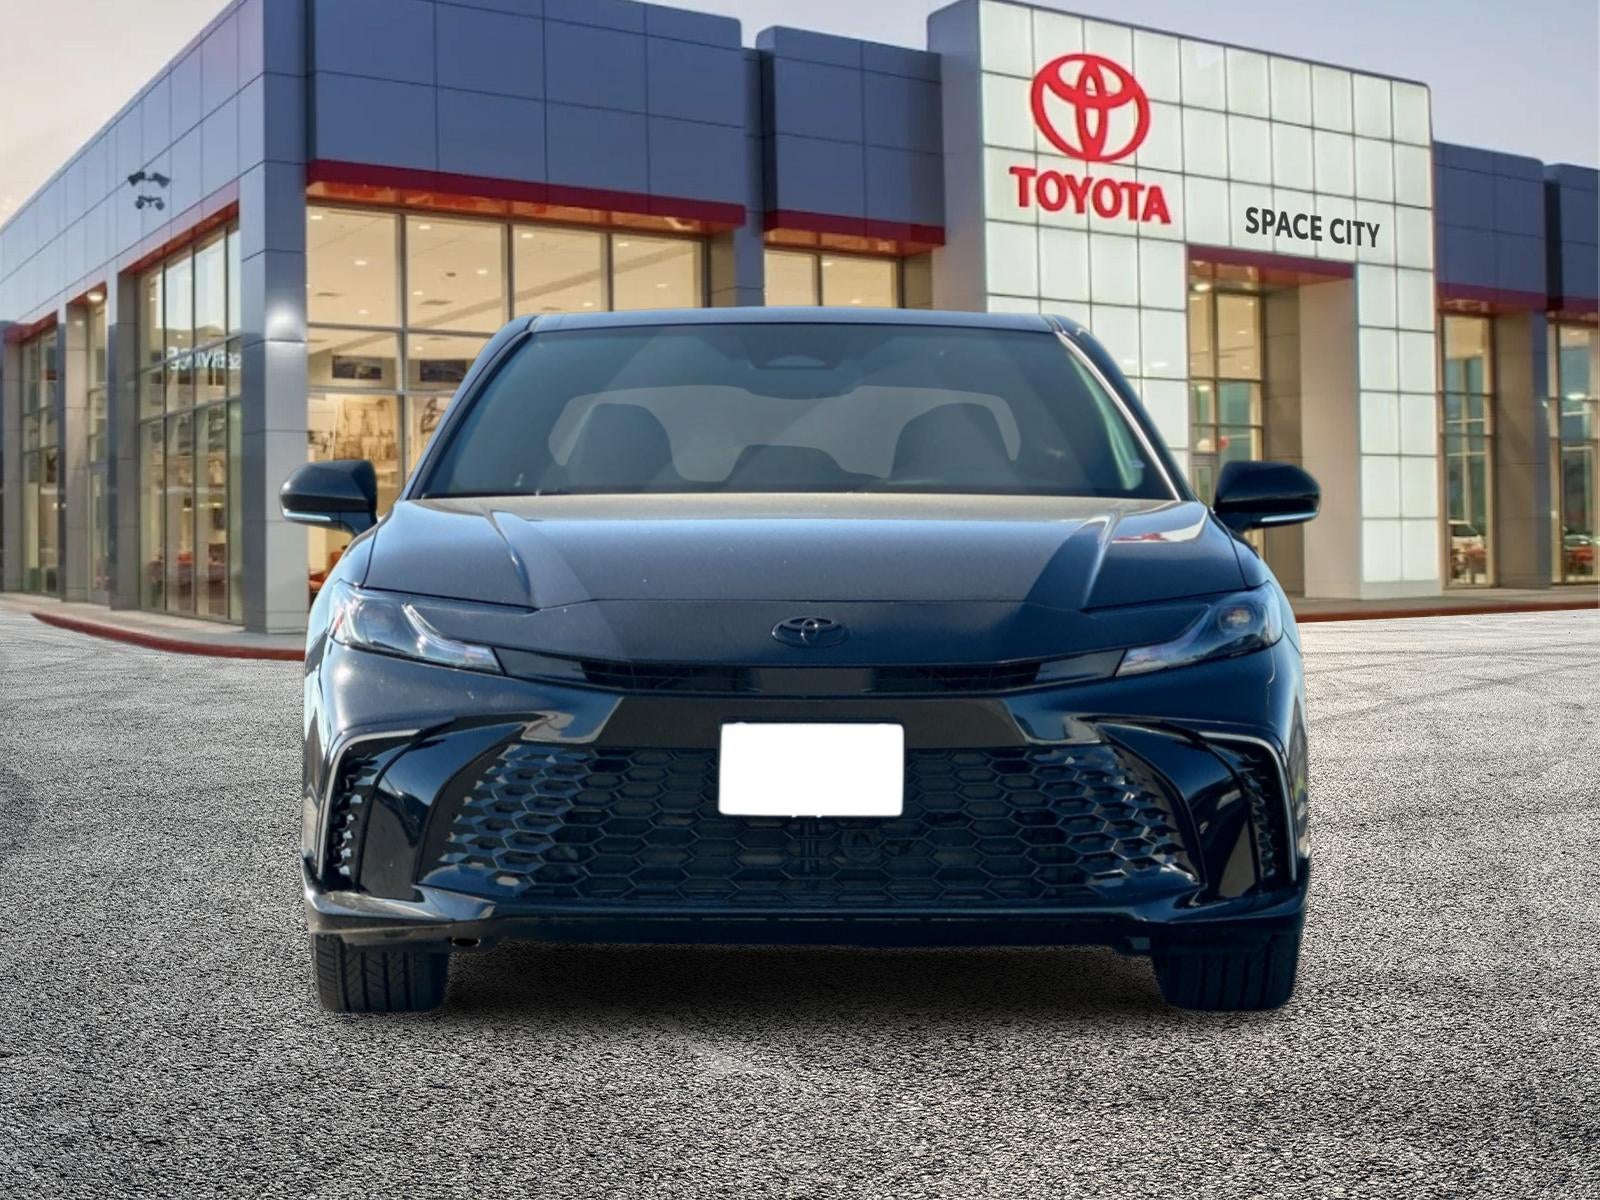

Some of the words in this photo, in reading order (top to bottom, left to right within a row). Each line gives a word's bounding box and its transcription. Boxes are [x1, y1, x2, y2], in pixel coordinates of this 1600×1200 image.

[1009, 166, 1171, 224] TOYOTA
[1245, 206, 1322, 241] SPACE
[1329, 218, 1380, 248] CITY
